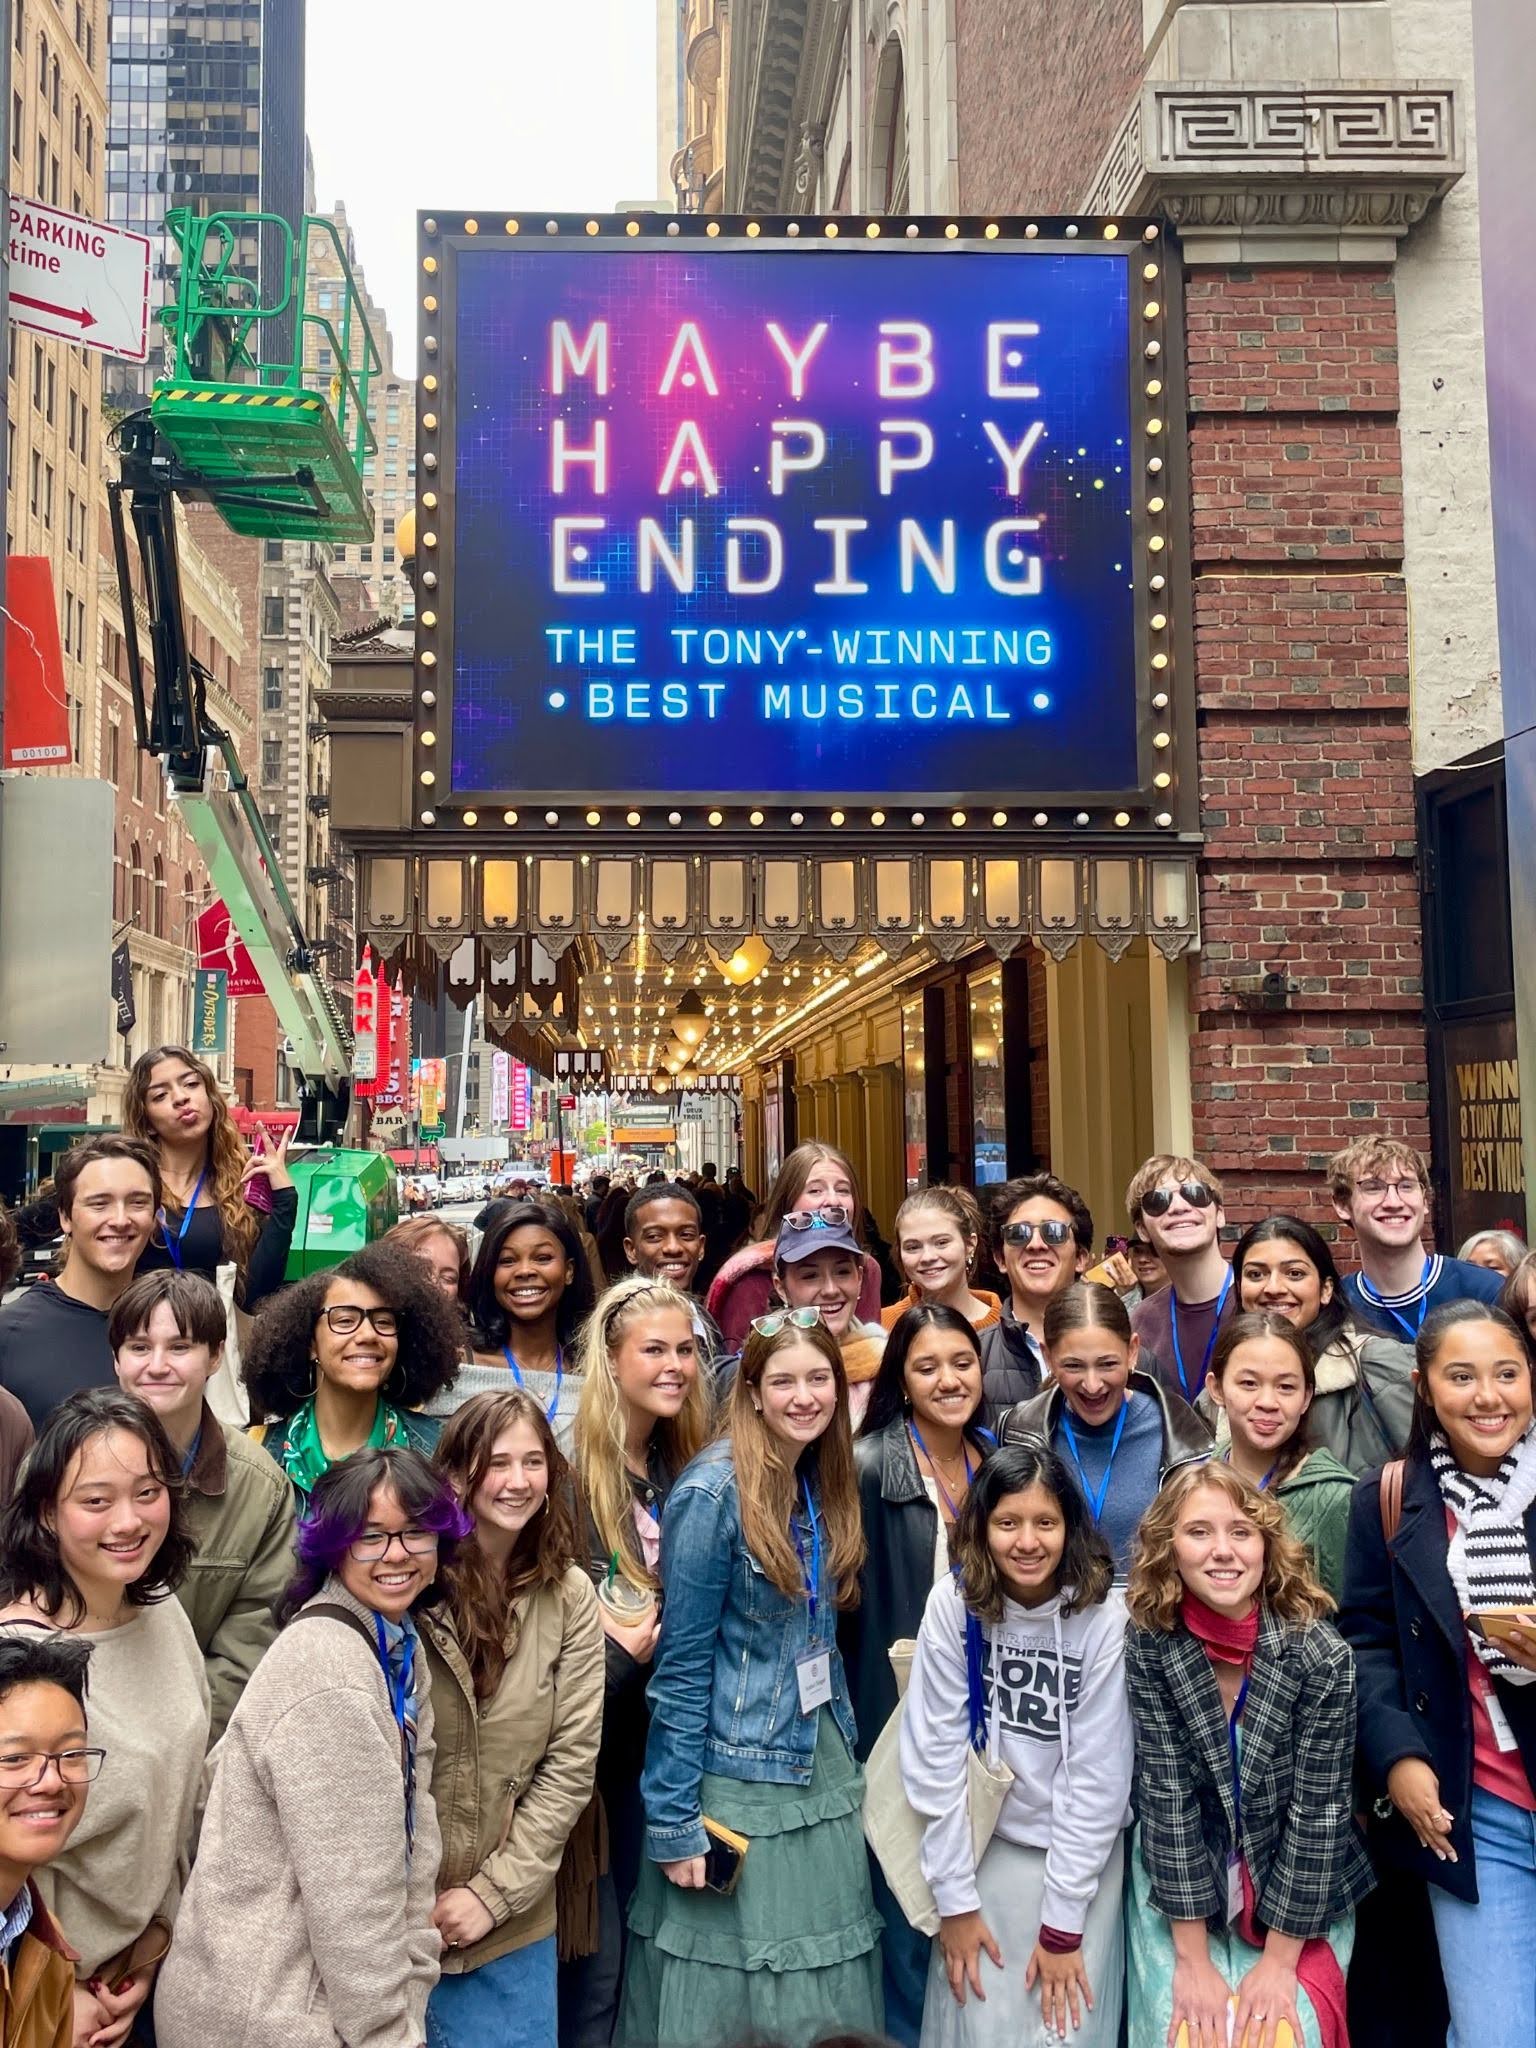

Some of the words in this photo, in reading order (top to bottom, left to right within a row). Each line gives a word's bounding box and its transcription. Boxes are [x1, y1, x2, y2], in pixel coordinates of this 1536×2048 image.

[552, 320, 1040, 397] MAYBE
[552, 420, 1044, 495] HAPPY
[553, 518, 1042, 594] ENDING
[545, 629, 636, 664] THE
[588, 684, 726, 719] BEST
[764, 684, 1010, 719] MUSICAL
[375, 1094, 404, 1104] BBQ
[376, 1116, 403, 1125] BAR
[1461, 1105, 1468, 1139] 8
[1469, 1104, 1499, 1138] TONY
[1461, 1142, 1493, 1191] BEST
[1006, 1646, 1037, 1658] THE
